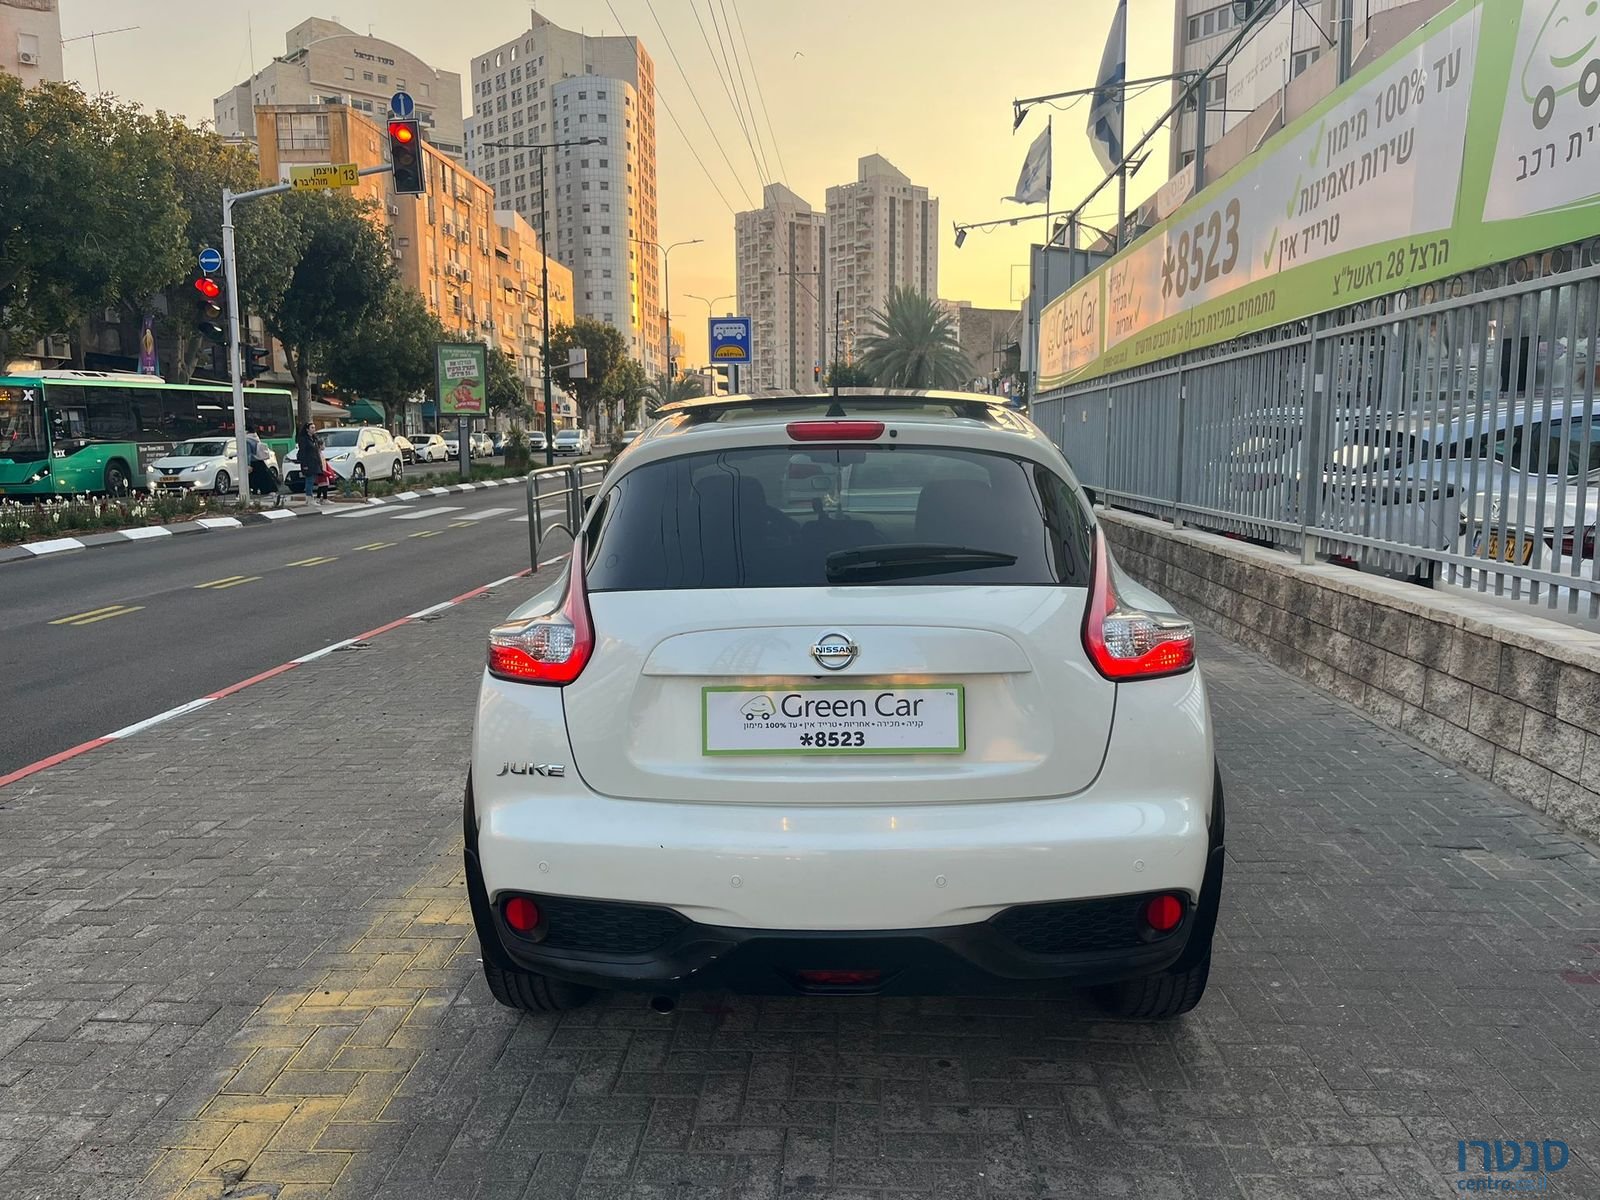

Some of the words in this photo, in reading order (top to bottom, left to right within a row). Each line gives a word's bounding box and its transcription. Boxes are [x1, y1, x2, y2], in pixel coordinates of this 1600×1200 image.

[1433, 47, 1462, 93] עד
[1375, 67, 1425, 129] 100%
[1326, 108, 1368, 168] מימון
[1566, 122, 1600, 162] ית
[313, 166, 332, 177] ויצמן
[1358, 127, 1415, 185] שירות
[1516, 143, 1556, 181] רכב
[299, 177, 328, 186] מוהליבר
[343, 169, 355, 181] 13
[1298, 160, 1356, 216] ואמינות
[1302, 213, 1340, 254] טרייד
[1278, 232, 1299, 273] אין
[1385, 248, 1405, 281] 28
[1410, 238, 1450, 273] הרצל
[1080, 291, 1097, 337] Car
[1206, 304, 1236, 333] במכירת
[1238, 289, 1276, 321] מתמחים
[815, 646, 853, 654] NISSAN
[781, 694, 866, 718] Green
[875, 692, 924, 717] Car
[743, 722, 763, 731] מימון
[789, 721, 798, 729] עד
[804, 721, 815, 730] אין
[876, 720, 900, 728] מכירה
[906, 720, 924, 728] קניה
[496, 761, 566, 777] JUKE
